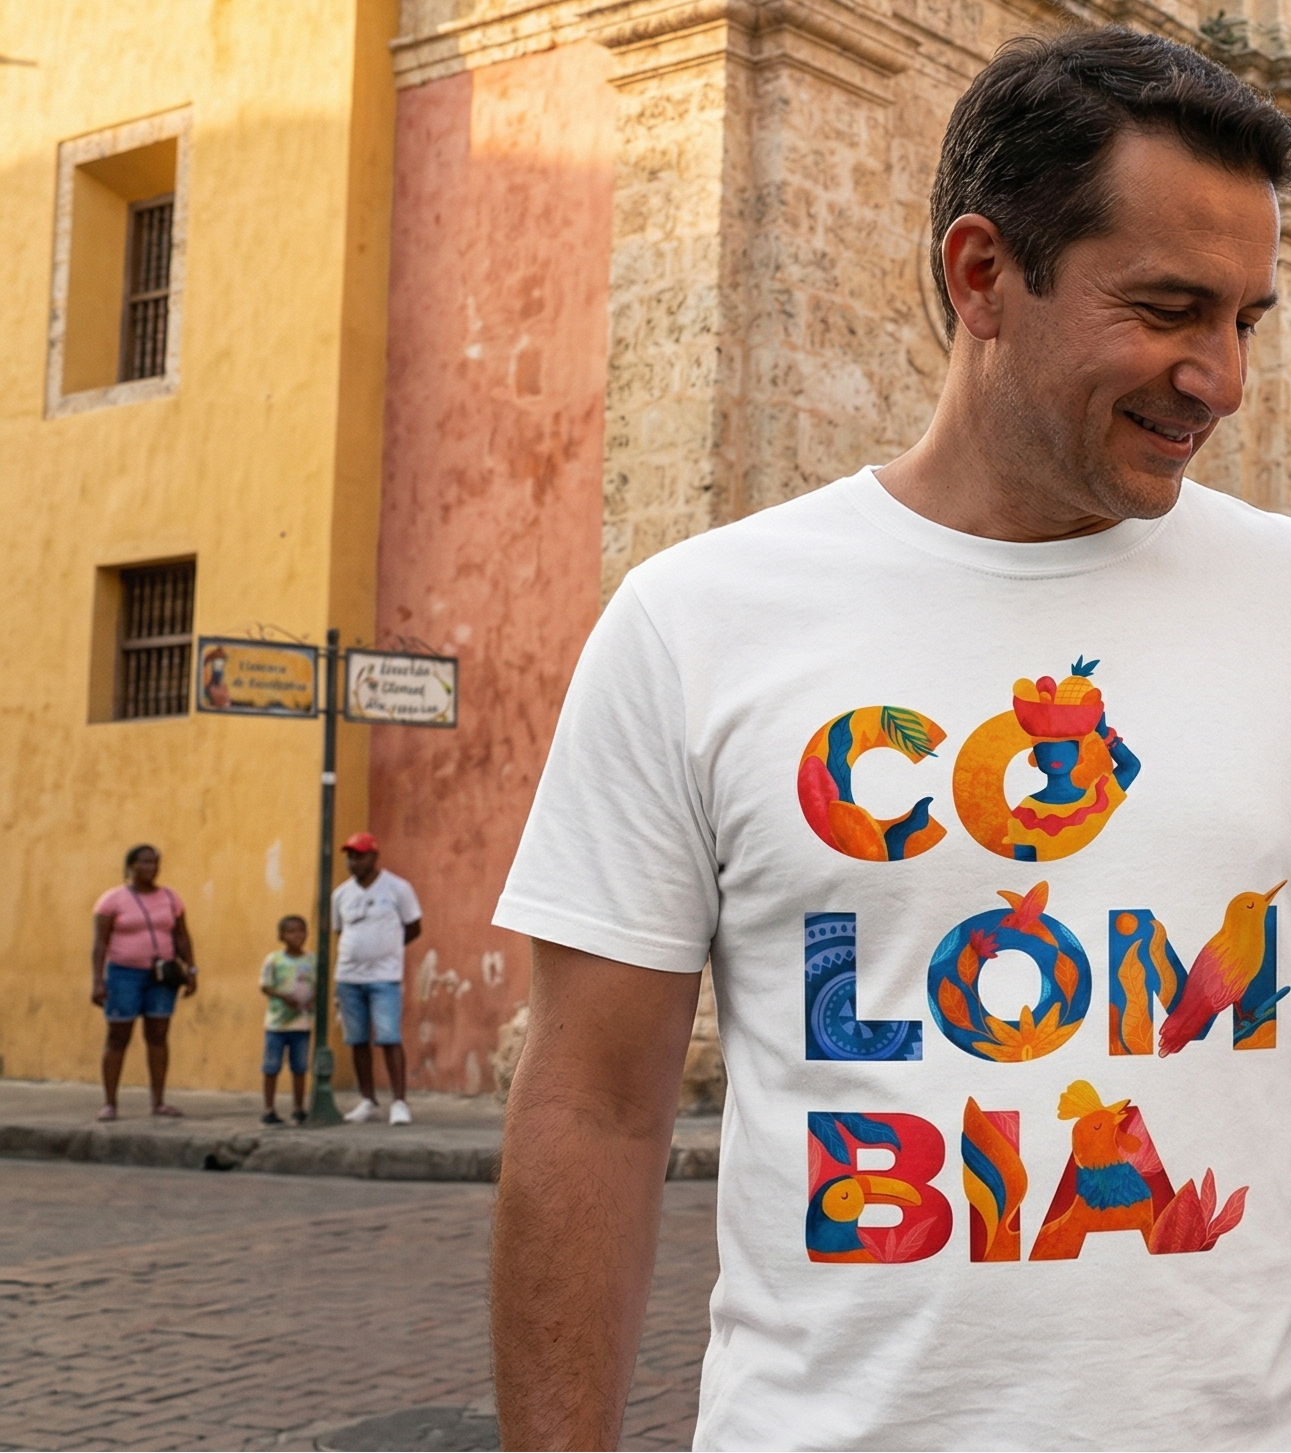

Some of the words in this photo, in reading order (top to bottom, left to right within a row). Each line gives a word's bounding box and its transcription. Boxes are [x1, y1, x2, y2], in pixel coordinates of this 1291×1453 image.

[797, 678, 1141, 863] CO
[804, 885, 1289, 1063] LOM
[804, 1082, 1249, 1264] BIA
